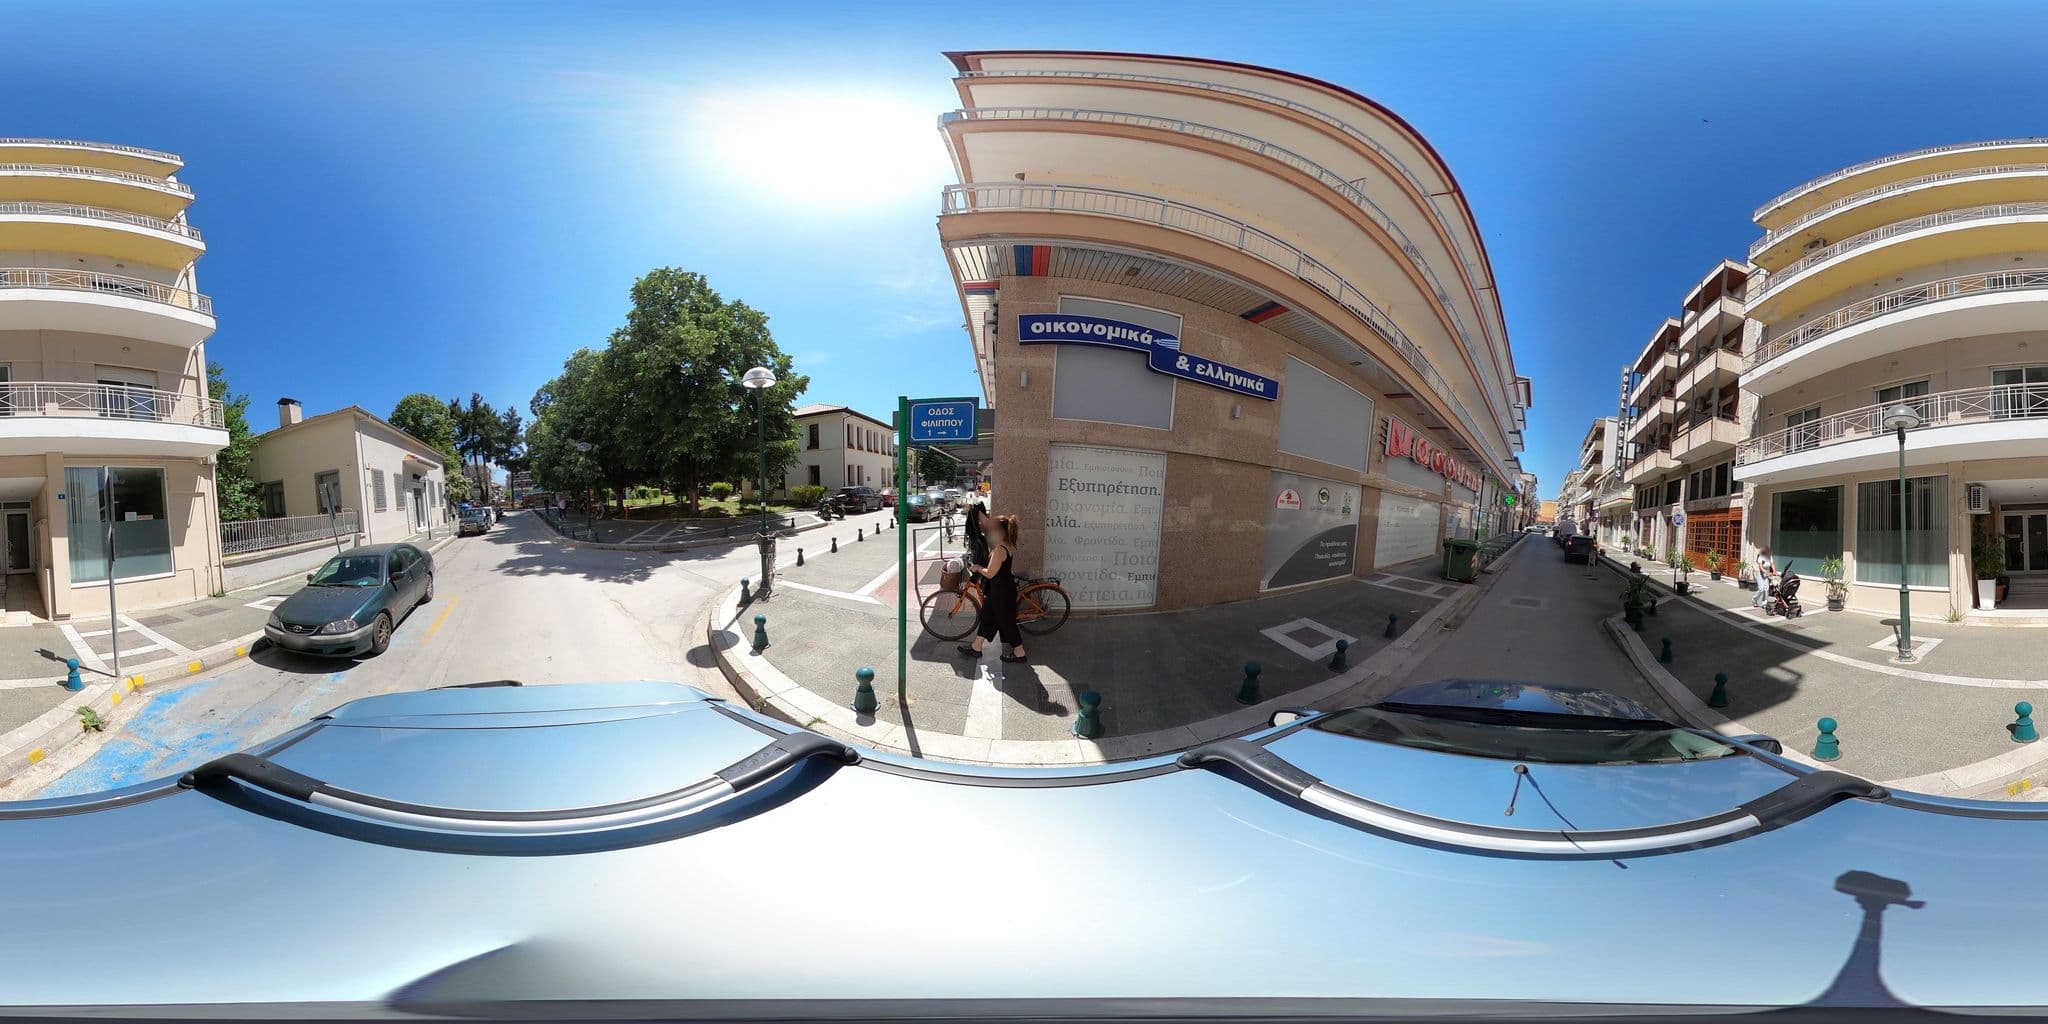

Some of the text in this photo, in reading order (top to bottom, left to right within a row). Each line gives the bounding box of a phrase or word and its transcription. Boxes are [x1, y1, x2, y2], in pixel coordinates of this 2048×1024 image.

[1031, 321, 1153, 344] οικονομικά
[1175, 355, 1265, 393] & ελληνικά
[1621, 367, 1630, 409] HOTEL
[928, 407, 955, 416] ΟΔΟΣ
[921, 419, 963, 427] ΦΙΛΙΠΠΟΥ
[927, 429, 932, 437] 1
[1058, 478, 1161, 496] Εξυπηρέτηση.
